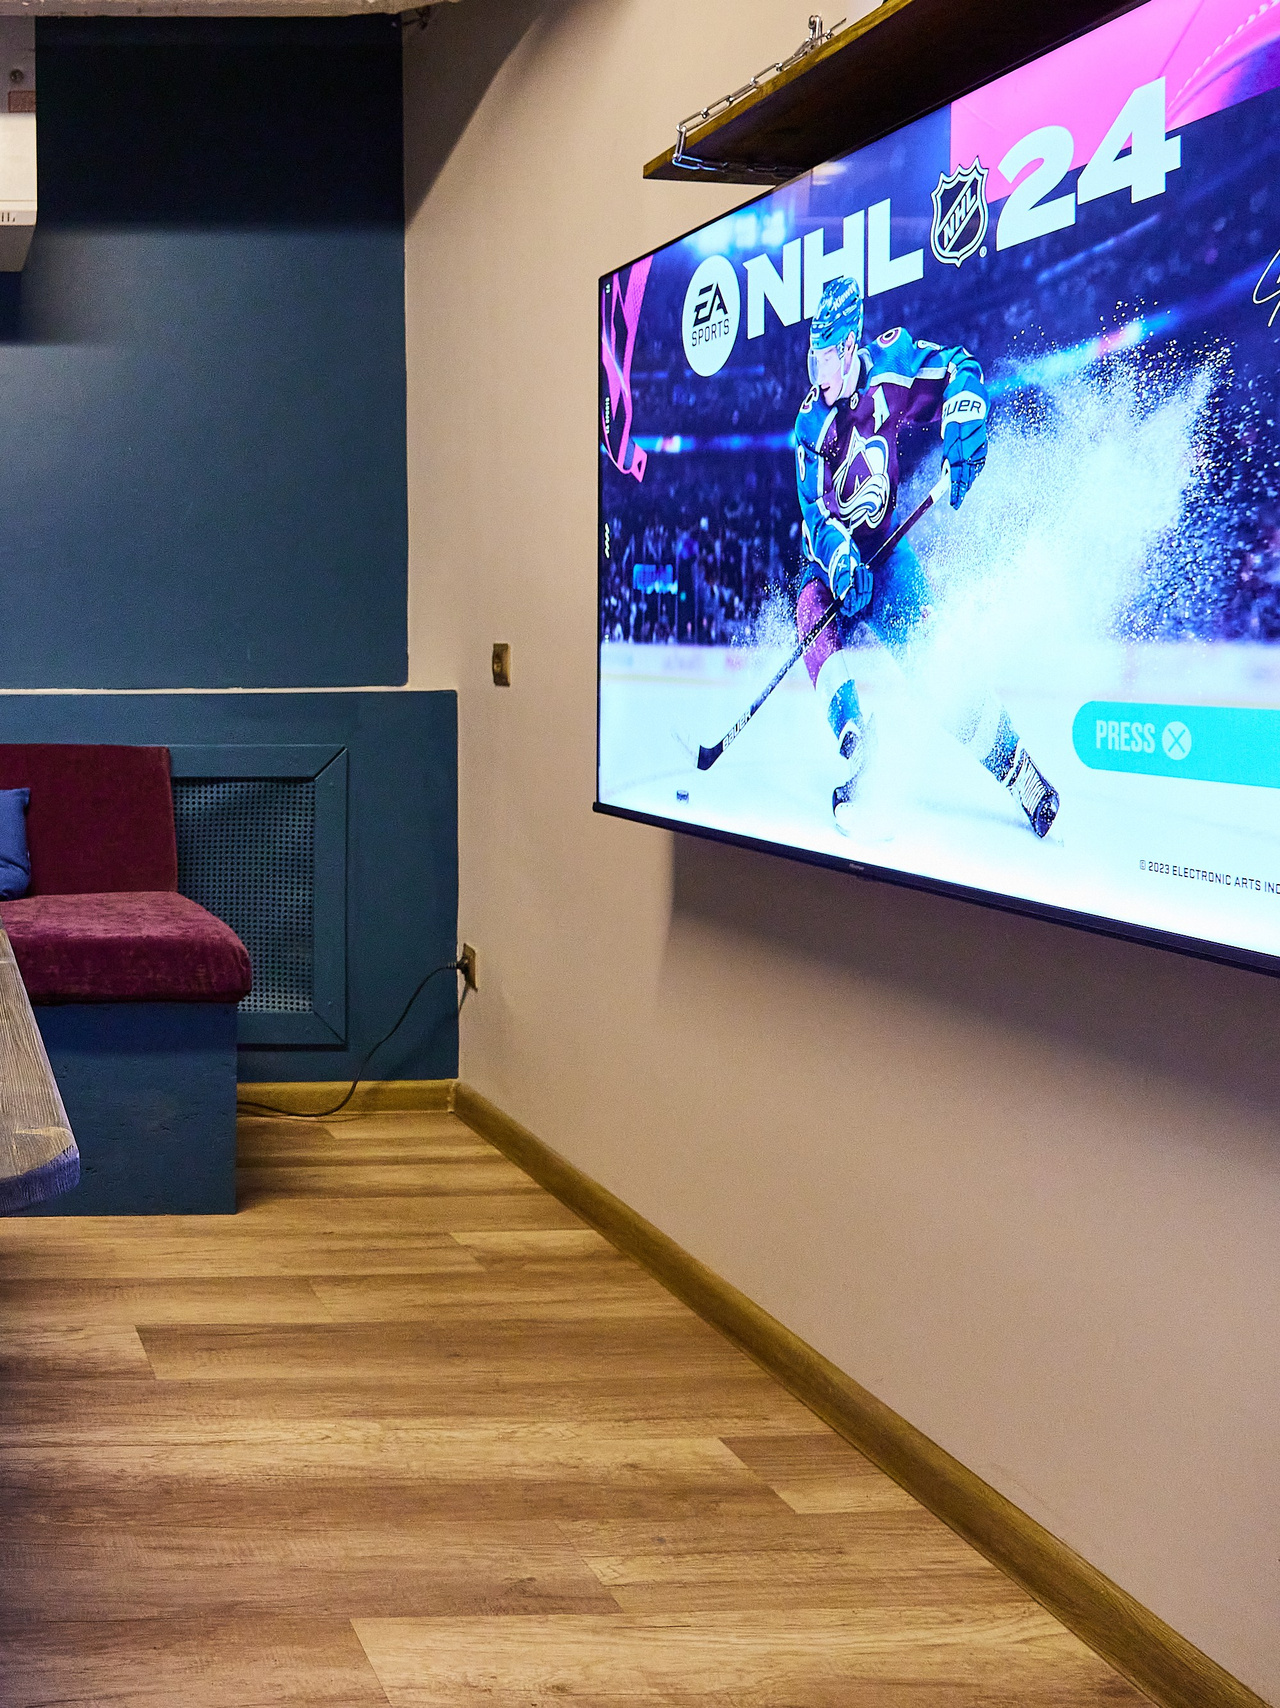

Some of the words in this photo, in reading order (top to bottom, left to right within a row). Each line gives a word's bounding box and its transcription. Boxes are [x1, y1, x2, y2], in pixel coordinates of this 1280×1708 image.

[743, 198, 924, 340] NHL
[997, 76, 1182, 252] 24
[943, 187, 977, 249] NHL
[692, 282, 729, 328] EA
[691, 318, 731, 347] SPORTS
[1096, 719, 1156, 754] PRESS
[1148, 861, 1170, 874] 2023
[1172, 865, 1232, 887] ELECTRONIC
[1234, 877, 1262, 892] ARTS
